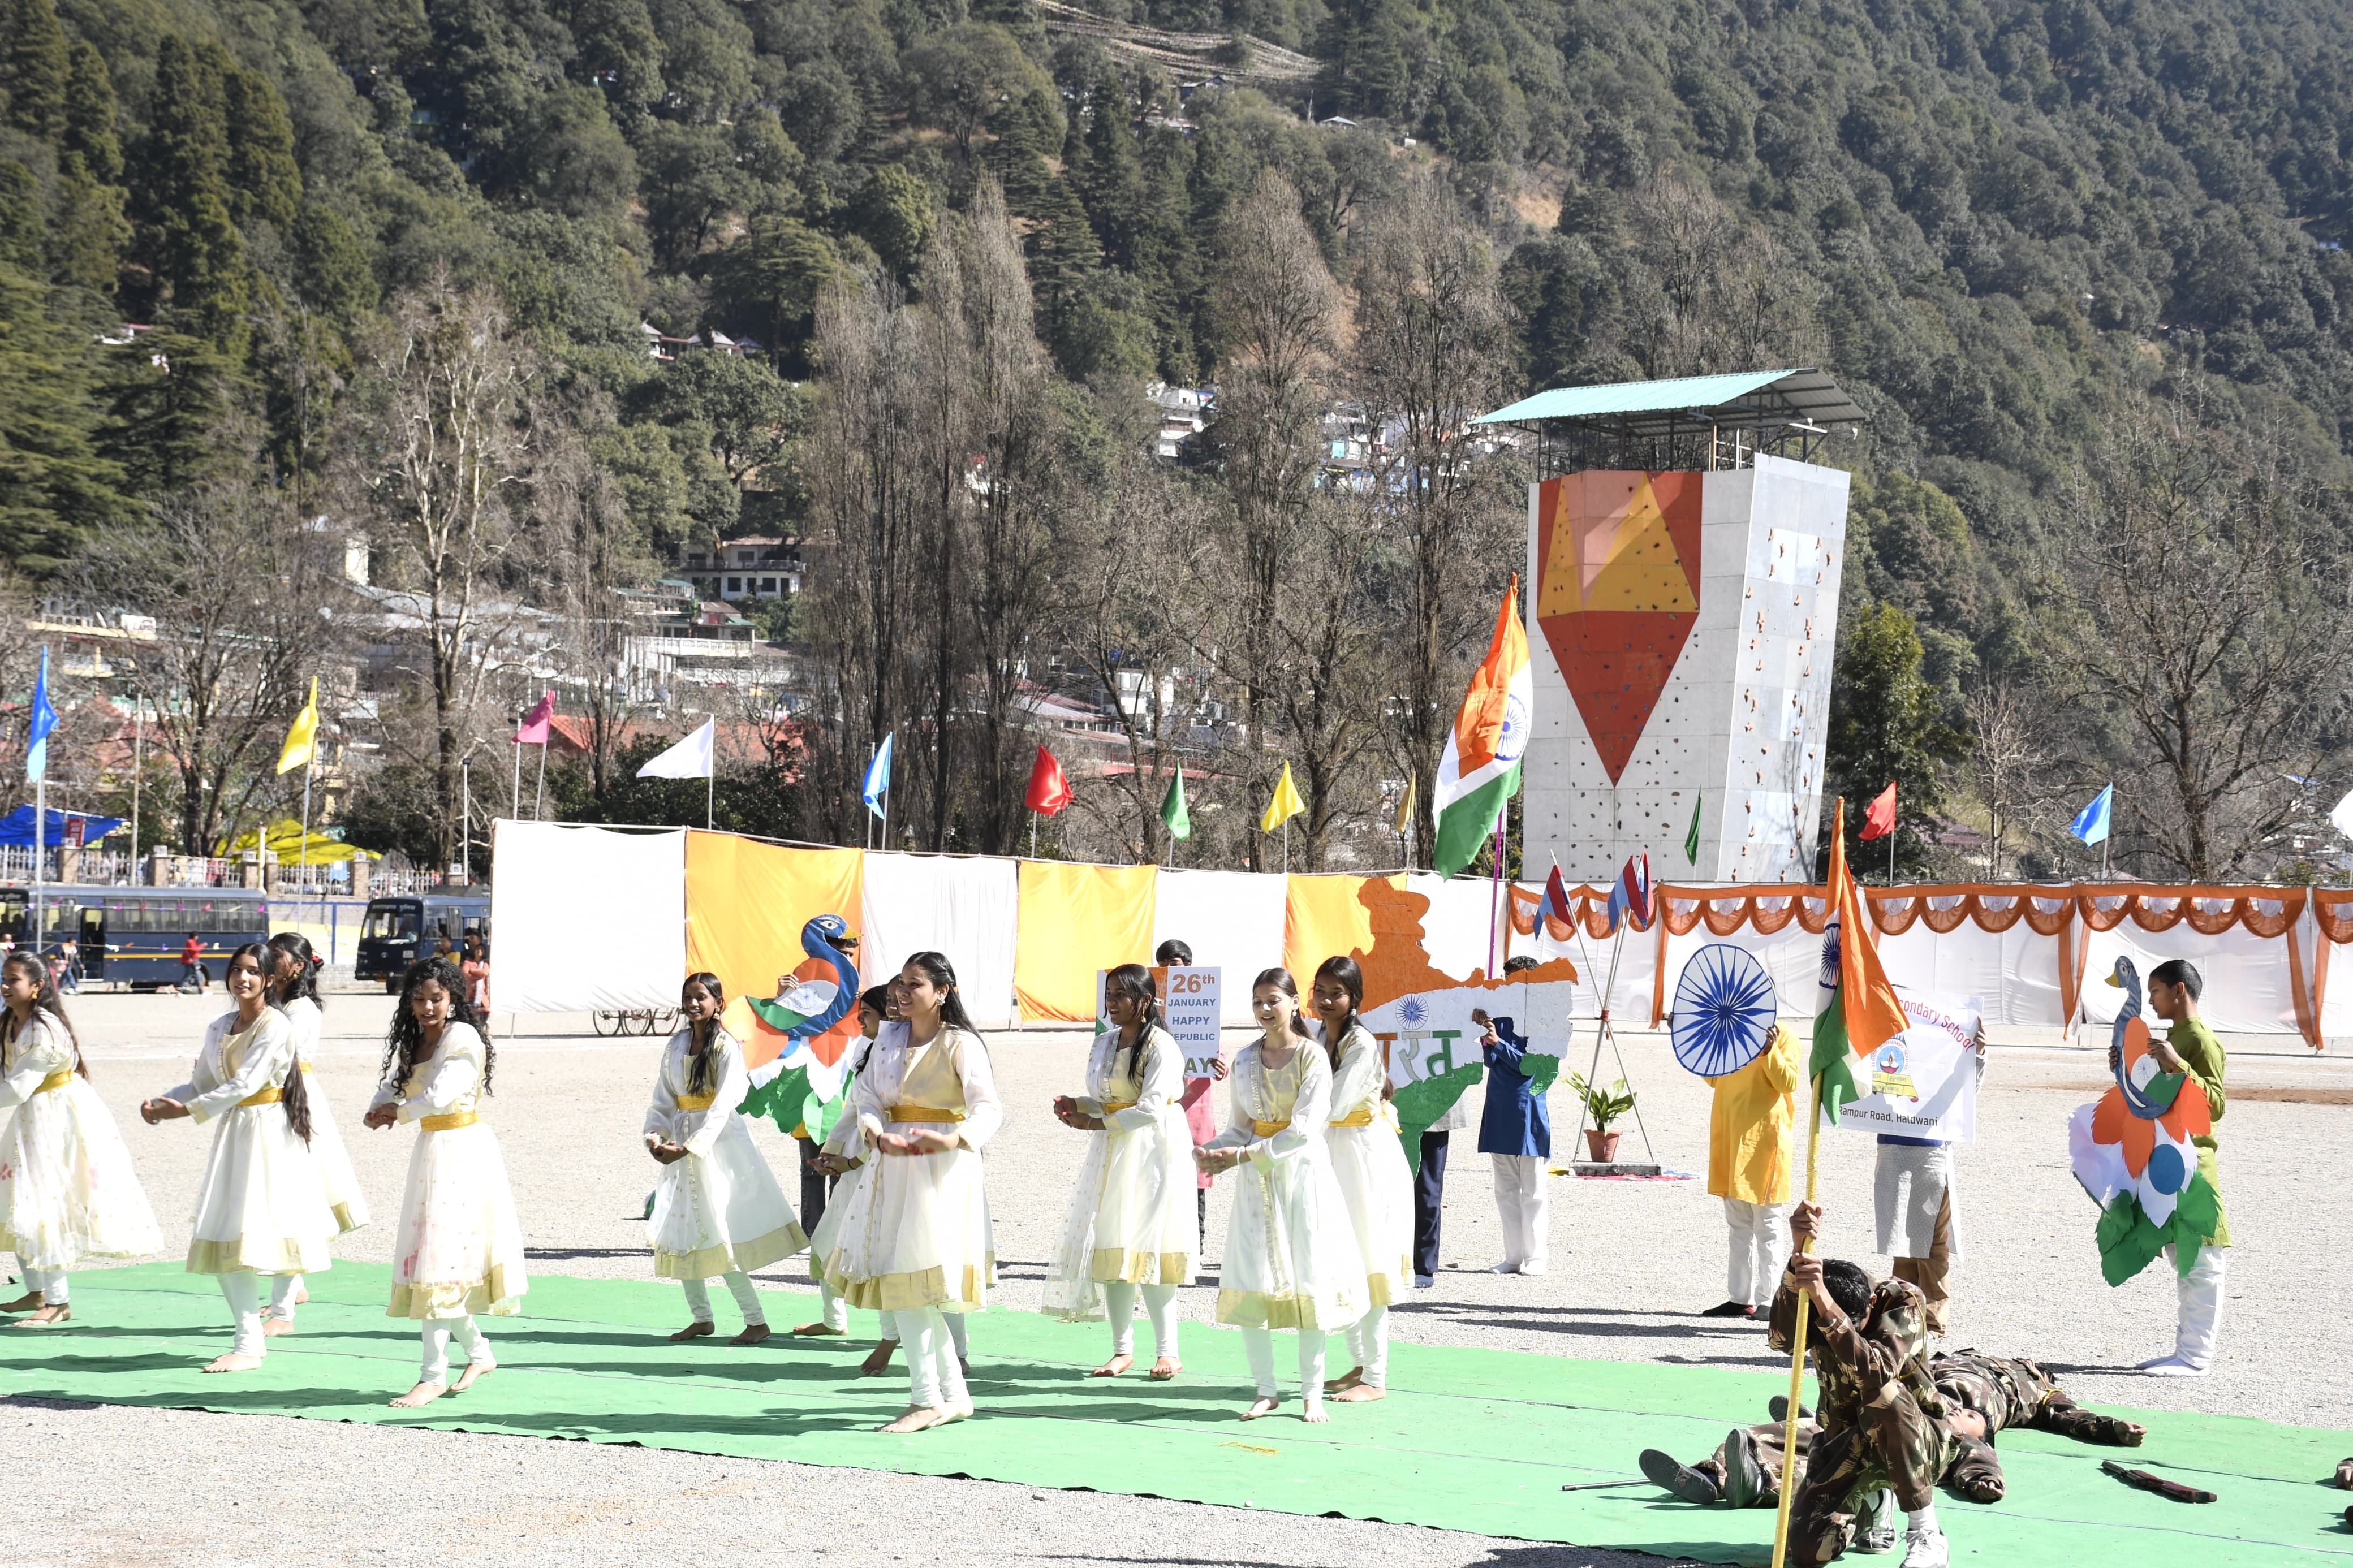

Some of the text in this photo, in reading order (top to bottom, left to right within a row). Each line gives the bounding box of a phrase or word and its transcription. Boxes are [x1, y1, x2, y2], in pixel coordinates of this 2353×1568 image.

[1171, 974, 1215, 993] 26th
[1172, 1016, 1210, 1025] HAPPY
[1941, 1015, 1975, 1053] School
[1184, 1057, 1213, 1073] AY
[1373, 1030, 1462, 1082] ारत
[1839, 1106, 1868, 1118] Rampur
[1897, 1114, 1937, 1126] Haldwani
